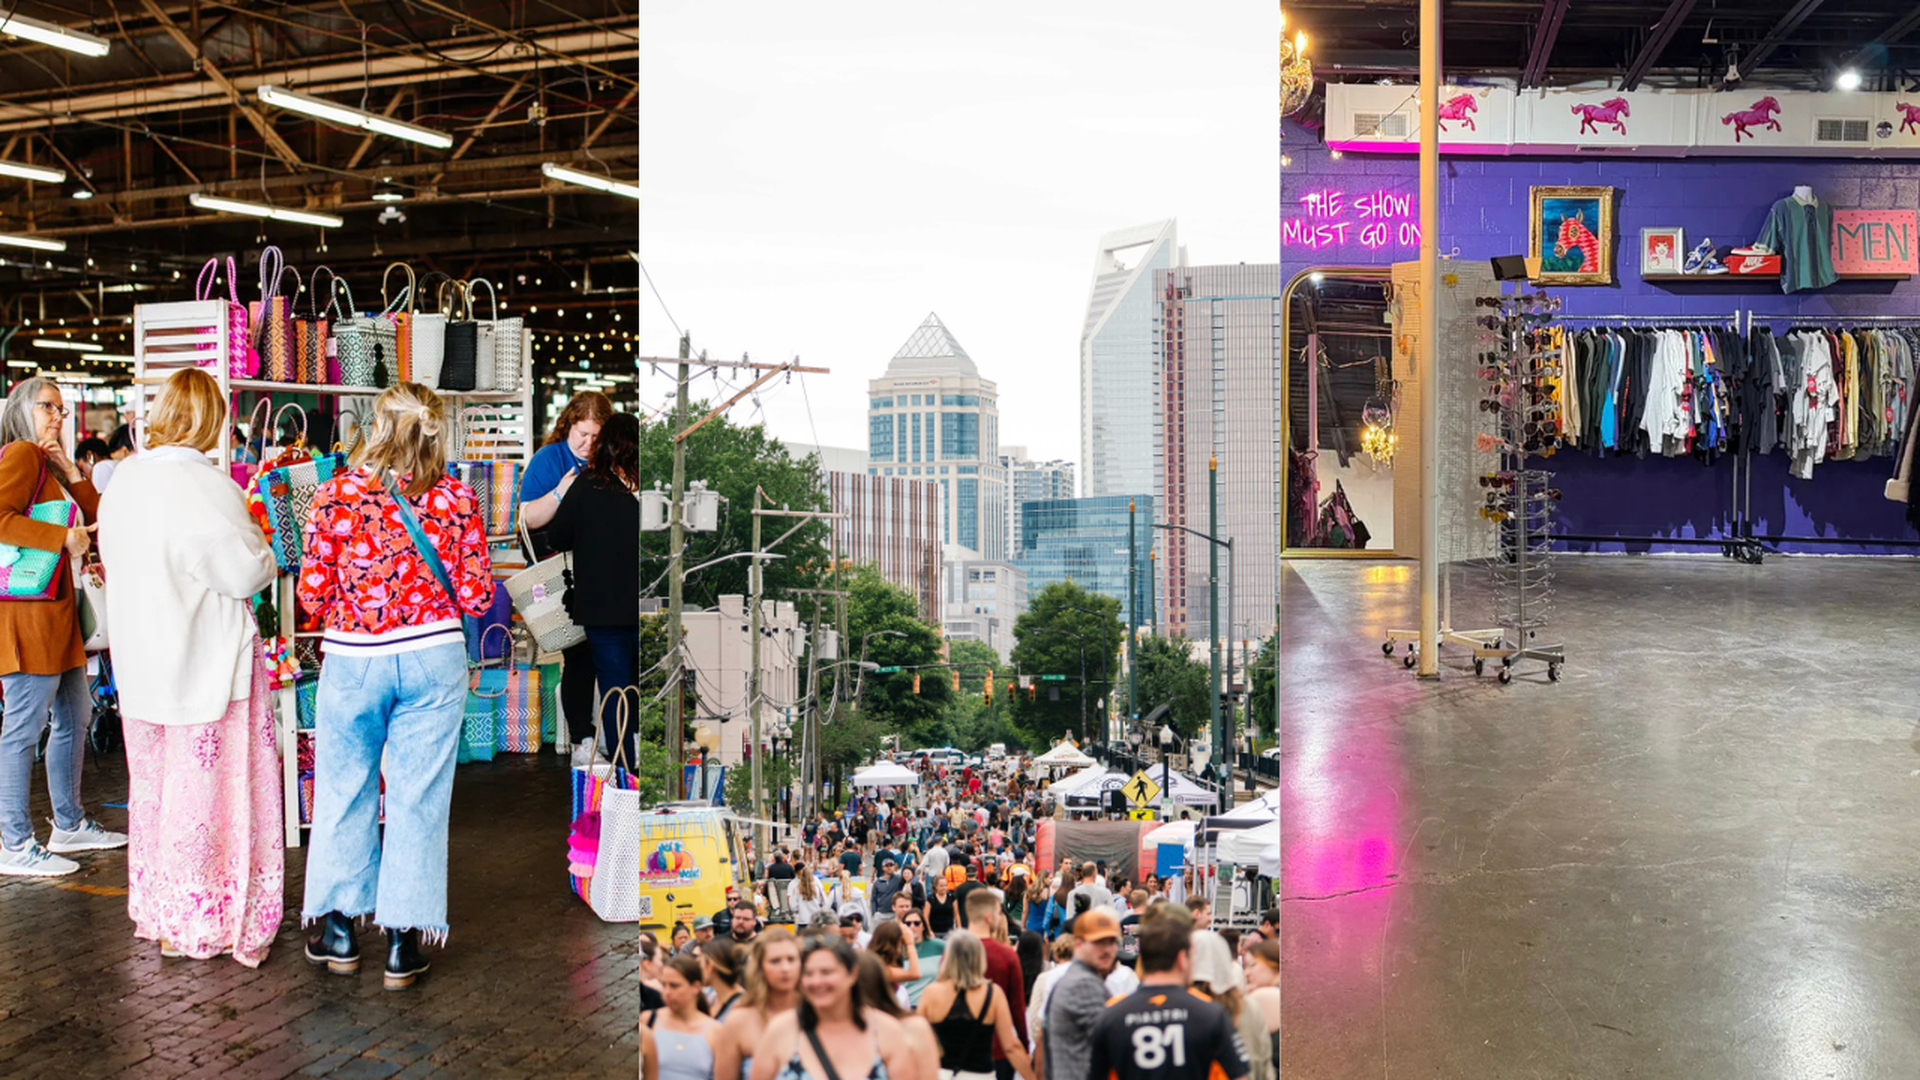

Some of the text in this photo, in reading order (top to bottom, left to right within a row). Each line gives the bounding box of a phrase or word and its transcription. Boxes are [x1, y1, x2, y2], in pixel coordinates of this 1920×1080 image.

[1300, 189, 1411, 218] THE SHOW
[1283, 219, 1350, 248] MUST
[1361, 222, 1387, 248] GO
[1836, 222, 1909, 262] MEN
[1743, 256, 1765, 267] NIKE
[1124, 1008, 1188, 1027] PIASTRI
[1131, 1023, 1187, 1070] 81
